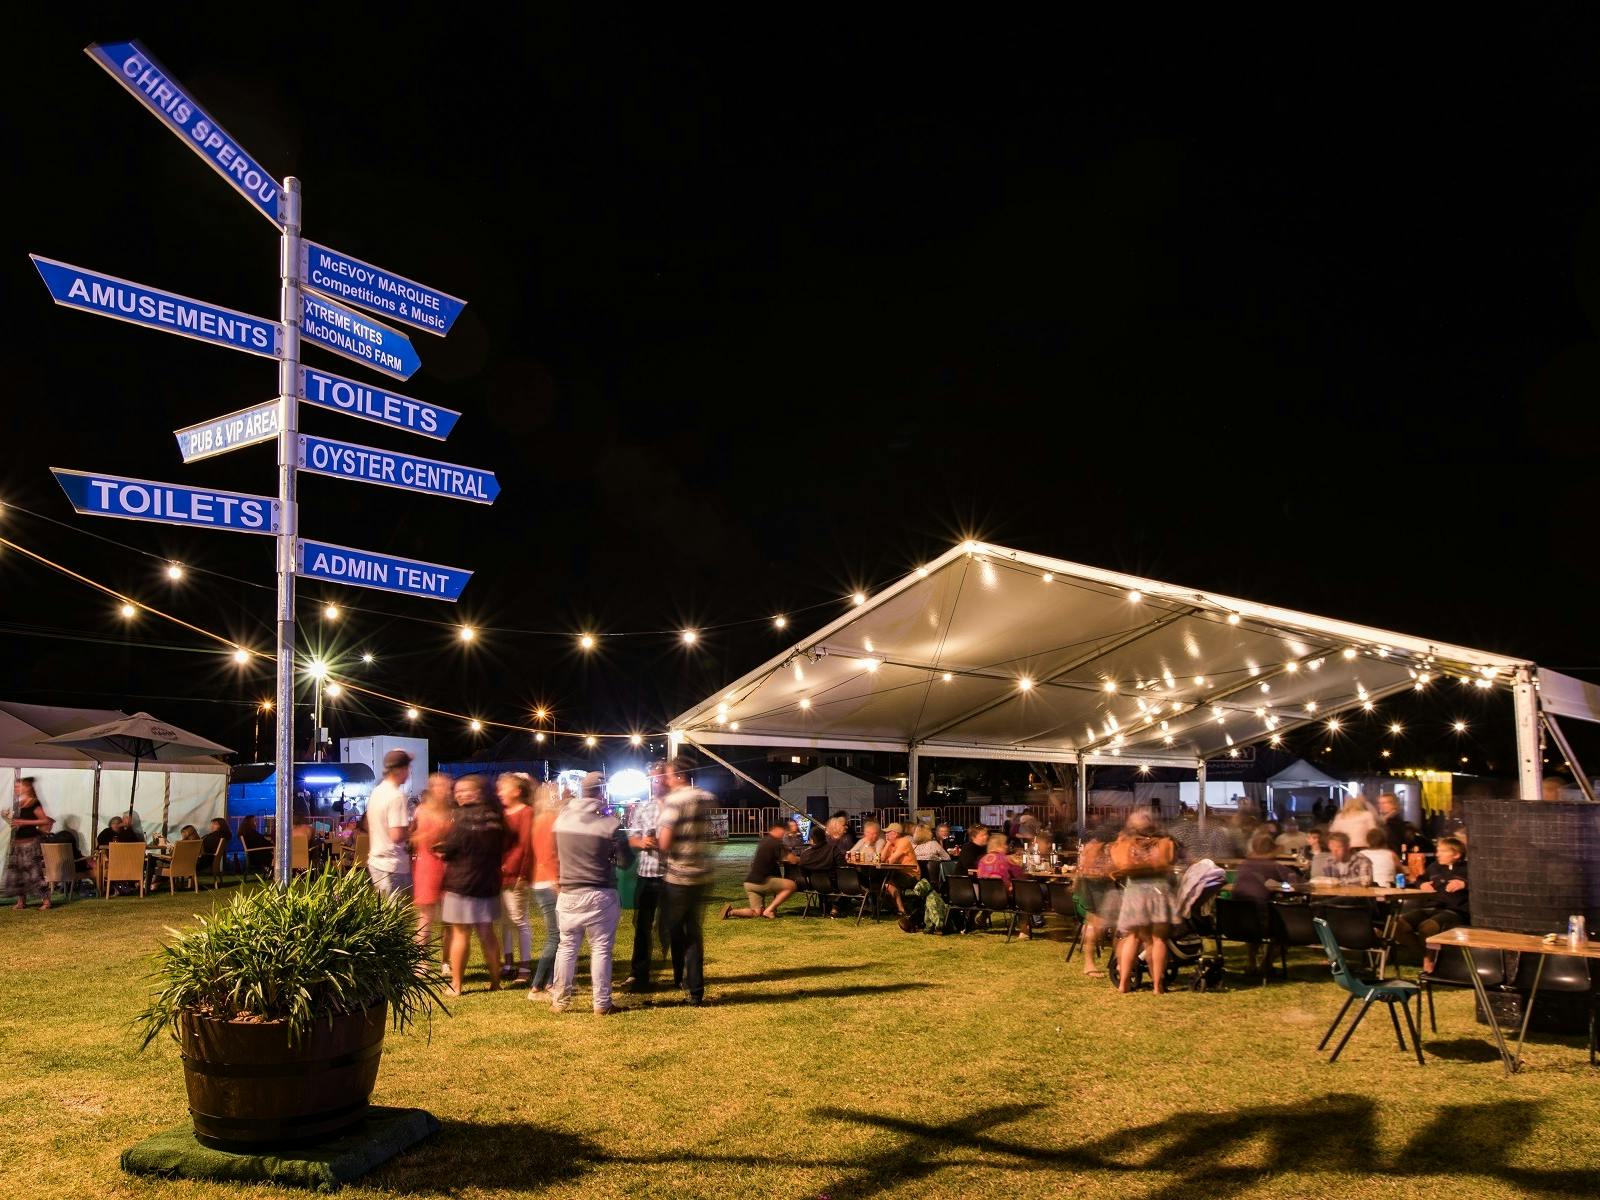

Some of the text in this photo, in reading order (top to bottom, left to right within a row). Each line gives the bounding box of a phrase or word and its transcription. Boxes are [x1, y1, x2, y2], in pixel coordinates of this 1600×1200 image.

[123, 57, 275, 203] CHRIS SPEROU
[312, 270, 445, 329] Competitions & Music
[320, 254, 440, 310] McEVOY MARQUEE
[68, 278, 268, 347] AMUSEMENTS
[305, 300, 383, 345] XTREME KITES
[305, 319, 402, 371] McDONALDS FARM
[312, 375, 437, 432] TOILETS
[190, 409, 277, 454] PUB & VIP AREA
[312, 444, 487, 498] OYSTER CENTRAL
[92, 480, 263, 527] TOILETS
[312, 553, 449, 593] ADMIN TENT
